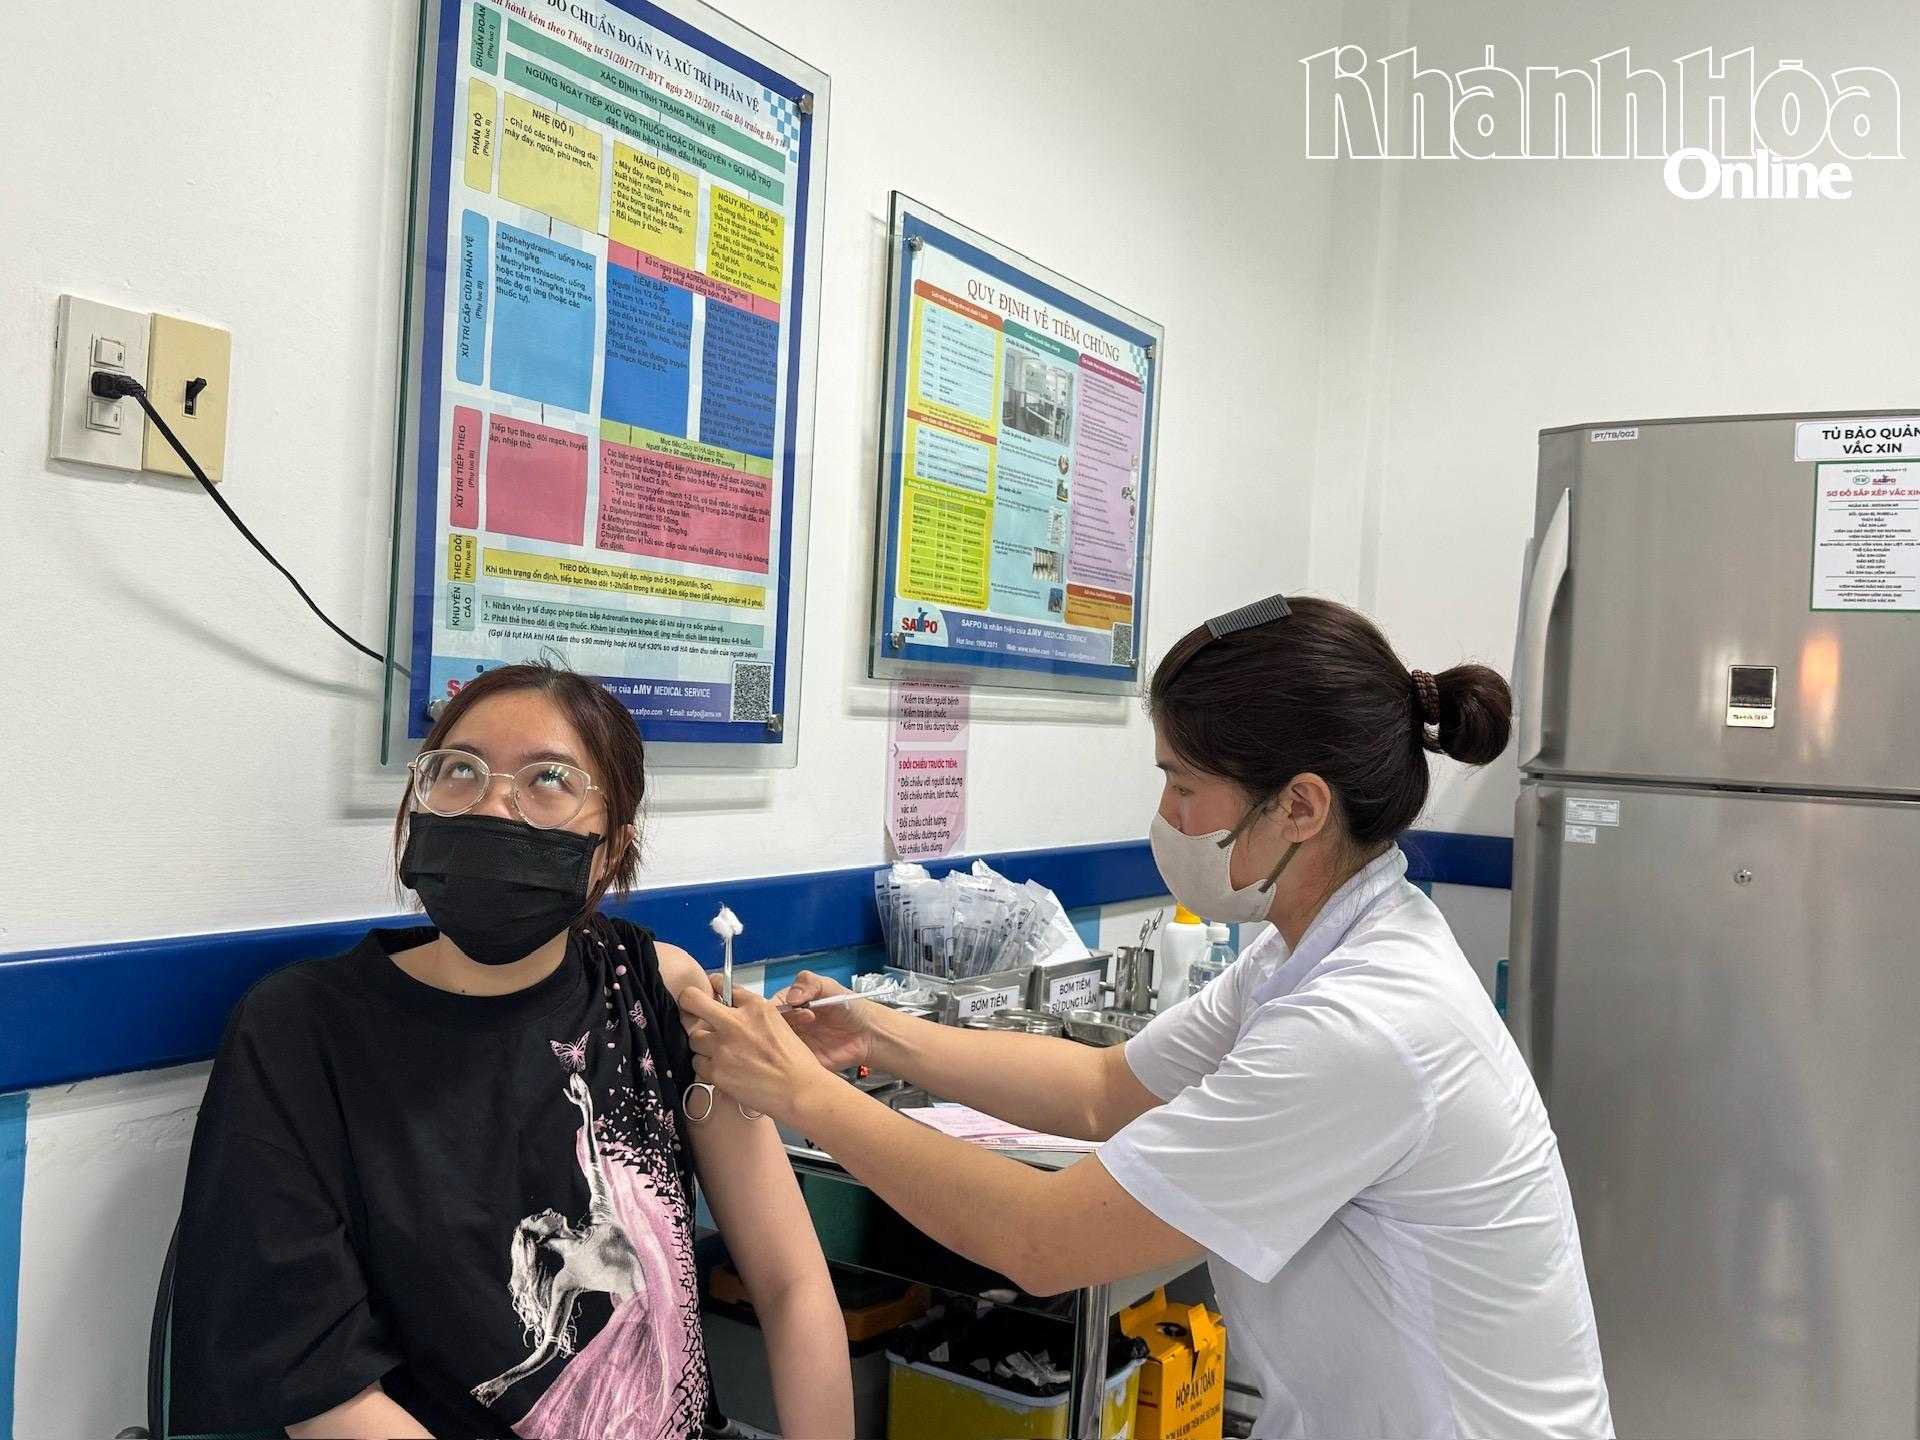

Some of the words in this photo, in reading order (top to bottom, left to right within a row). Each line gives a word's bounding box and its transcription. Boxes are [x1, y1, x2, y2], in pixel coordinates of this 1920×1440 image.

[571, 3, 614, 37] CHUẨN
[619, 28, 651, 56] ĐOÁN
[656, 47, 670, 66] VÀ
[674, 57, 690, 75] XỬ
[693, 66, 711, 88] TRÍ
[714, 78, 742, 103] PHẢN
[746, 95, 758, 112] VỆ
[547, 21, 565, 36] theo
[604, 48, 663, 85] 51/2017/TT-BYT
[665, 81, 681, 96] ngày
[684, 88, 720, 112] 29/12/2017
[720, 109, 732, 120] của
[734, 113, 743, 126] Bộ
[600, 69, 616, 85] XÁC
[618, 79, 637, 95] ĐỊNH
[639, 89, 657, 104] TÌNH
[658, 98, 684, 117] TRẠNG
[686, 111, 704, 129] PHẢN
[706, 122, 715, 134] VỆ
[473, 112, 483, 126] ĐỘ
[525, 65, 557, 87] NGỪNG
[559, 81, 582, 99] NGAY
[584, 93, 602, 107] TIẾP
[604, 102, 621, 116] XÚC
[623, 111, 637, 123] VỚI
[639, 117, 664, 137] THUỐC
[666, 131, 686, 147] HOẶC
[688, 142, 695, 154] DỊ
[697, 146, 726, 166] NGUYÊN
[732, 163, 744, 176] GỌI
[746, 169, 756, 181] HỖ
[758, 175, 771, 189] TRỢ
[532, 108, 549, 125] NHẸ
[551, 117, 566, 133] (ĐỘ
[568, 125, 574, 136] I)
[510, 117, 522, 129] Chỉ
[523, 124, 532, 133] có
[533, 130, 545, 139] các
[547, 134, 562, 146] triệu
[563, 143, 585, 157] chứng
[620, 123, 640, 138] người
[633, 154, 655, 169] NẶNG
[658, 165, 670, 179] (ĐỘ
[718, 192, 737, 206] NGUY
[757, 210, 769, 223] (ĐỘ
[465, 235, 474, 247] VỆ
[463, 279, 472, 300] CỨU
[462, 303, 471, 322] CẤP
[967, 279, 994, 304] QUY
[999, 292, 1029, 321] ĐỊNH
[1034, 306, 1048, 329] VỀ
[1052, 318, 1079, 344] TIÊM
[1082, 332, 1119, 361] CHỦNG
[461, 324, 470, 340] TRÍ
[461, 343, 469, 357] XỬ
[457, 424, 465, 450] THEO
[520, 429, 534, 439] theo
[1595, 431, 1634, 439] PT/TB/002
[1822, 426, 1840, 440] TỦ
[1845, 425, 1877, 439] BẢO
[1880, 424, 1920, 439] QUẢN
[1843, 440, 1872, 454] VẮC
[1876, 443, 1902, 453] XIN
[455, 453, 464, 474] TIẾP
[455, 477, 463, 492] TRÍ
[1840, 488, 1851, 497] ĐỒ
[455, 494, 463, 508] XỬ
[453, 553, 461, 579] THEO
[463, 597, 471, 617] CÁO
[902, 616, 938, 634] SAFPO
[961, 618, 981, 628] SAFPO
[618, 685, 631, 693] của
[633, 684, 651, 694] AMV
[654, 685, 682, 696] MEDICAL
[684, 687, 710, 697] SERVICE
[1060, 981, 1074, 995] BƠM
[1075, 977, 1091, 990] TIÊM
[971, 1000, 988, 1012] BƠM
[990, 993, 1008, 1007] TIÊM
[1176, 1382, 1189, 1411] HỘP
